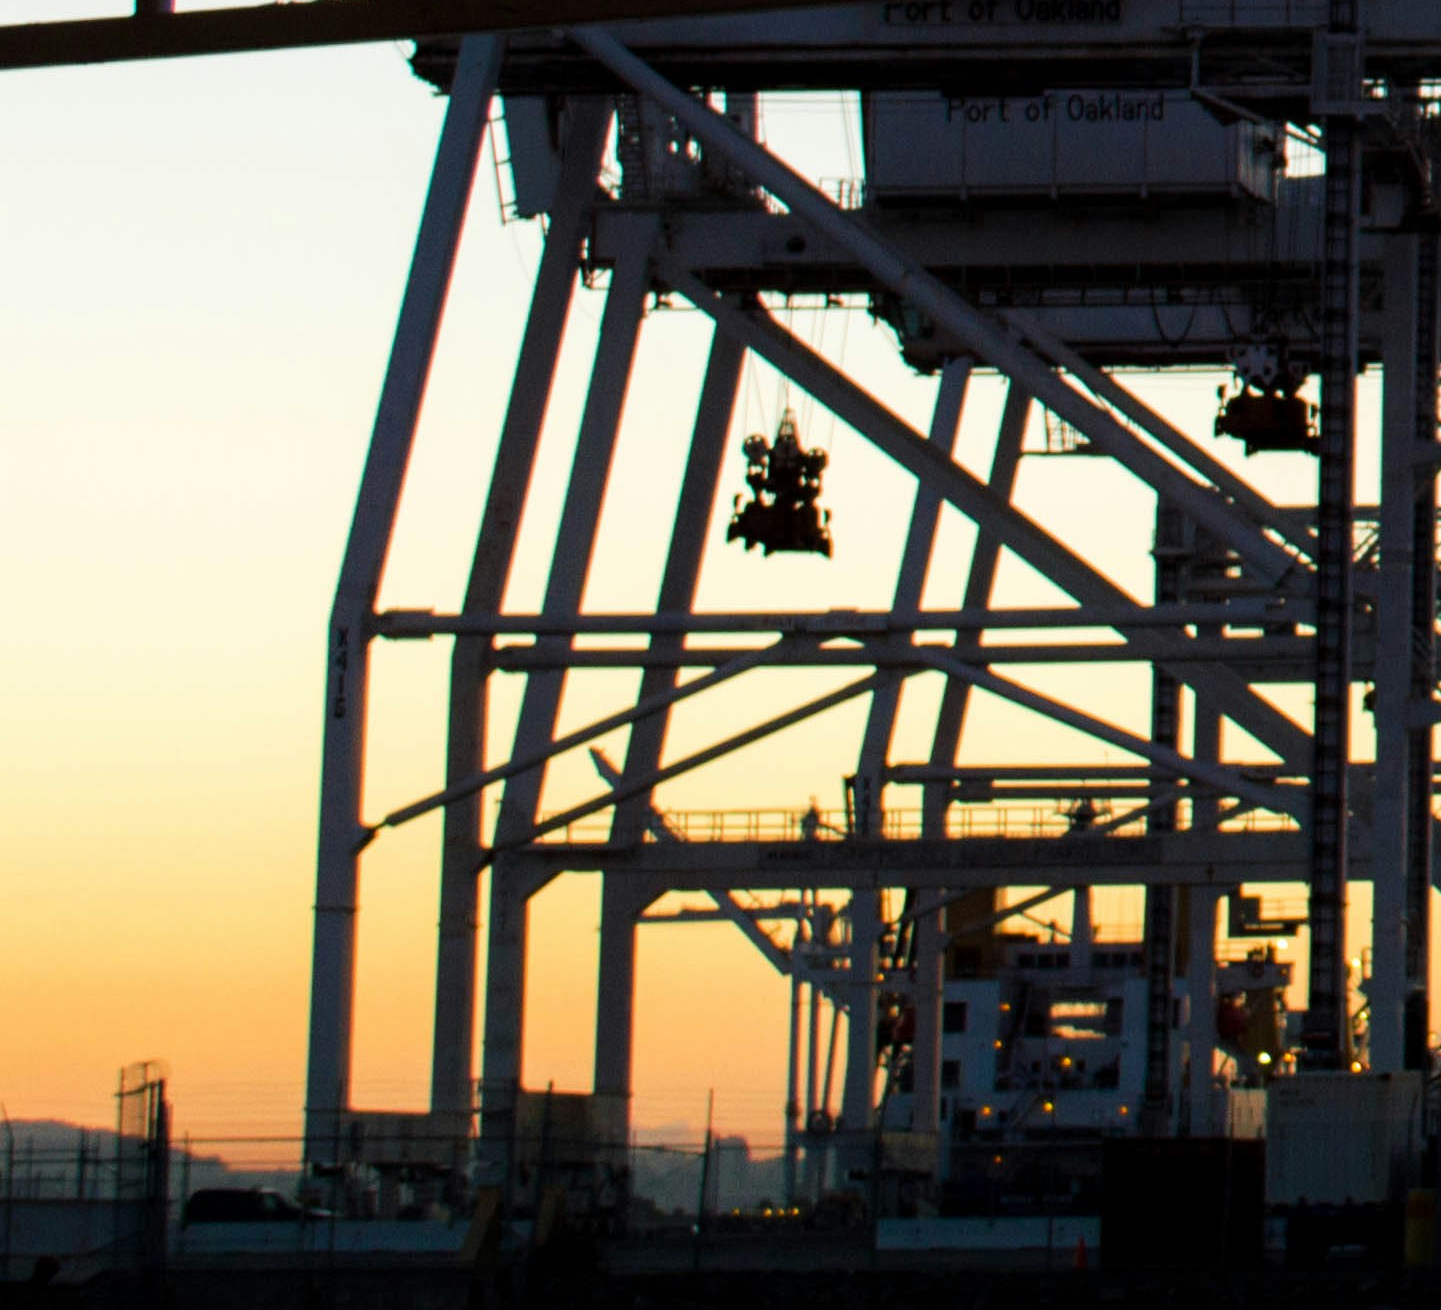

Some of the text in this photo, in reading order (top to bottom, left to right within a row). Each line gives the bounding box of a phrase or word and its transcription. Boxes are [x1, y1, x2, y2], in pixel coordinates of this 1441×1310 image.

[946, 91, 1165, 123] Port of Oakland
